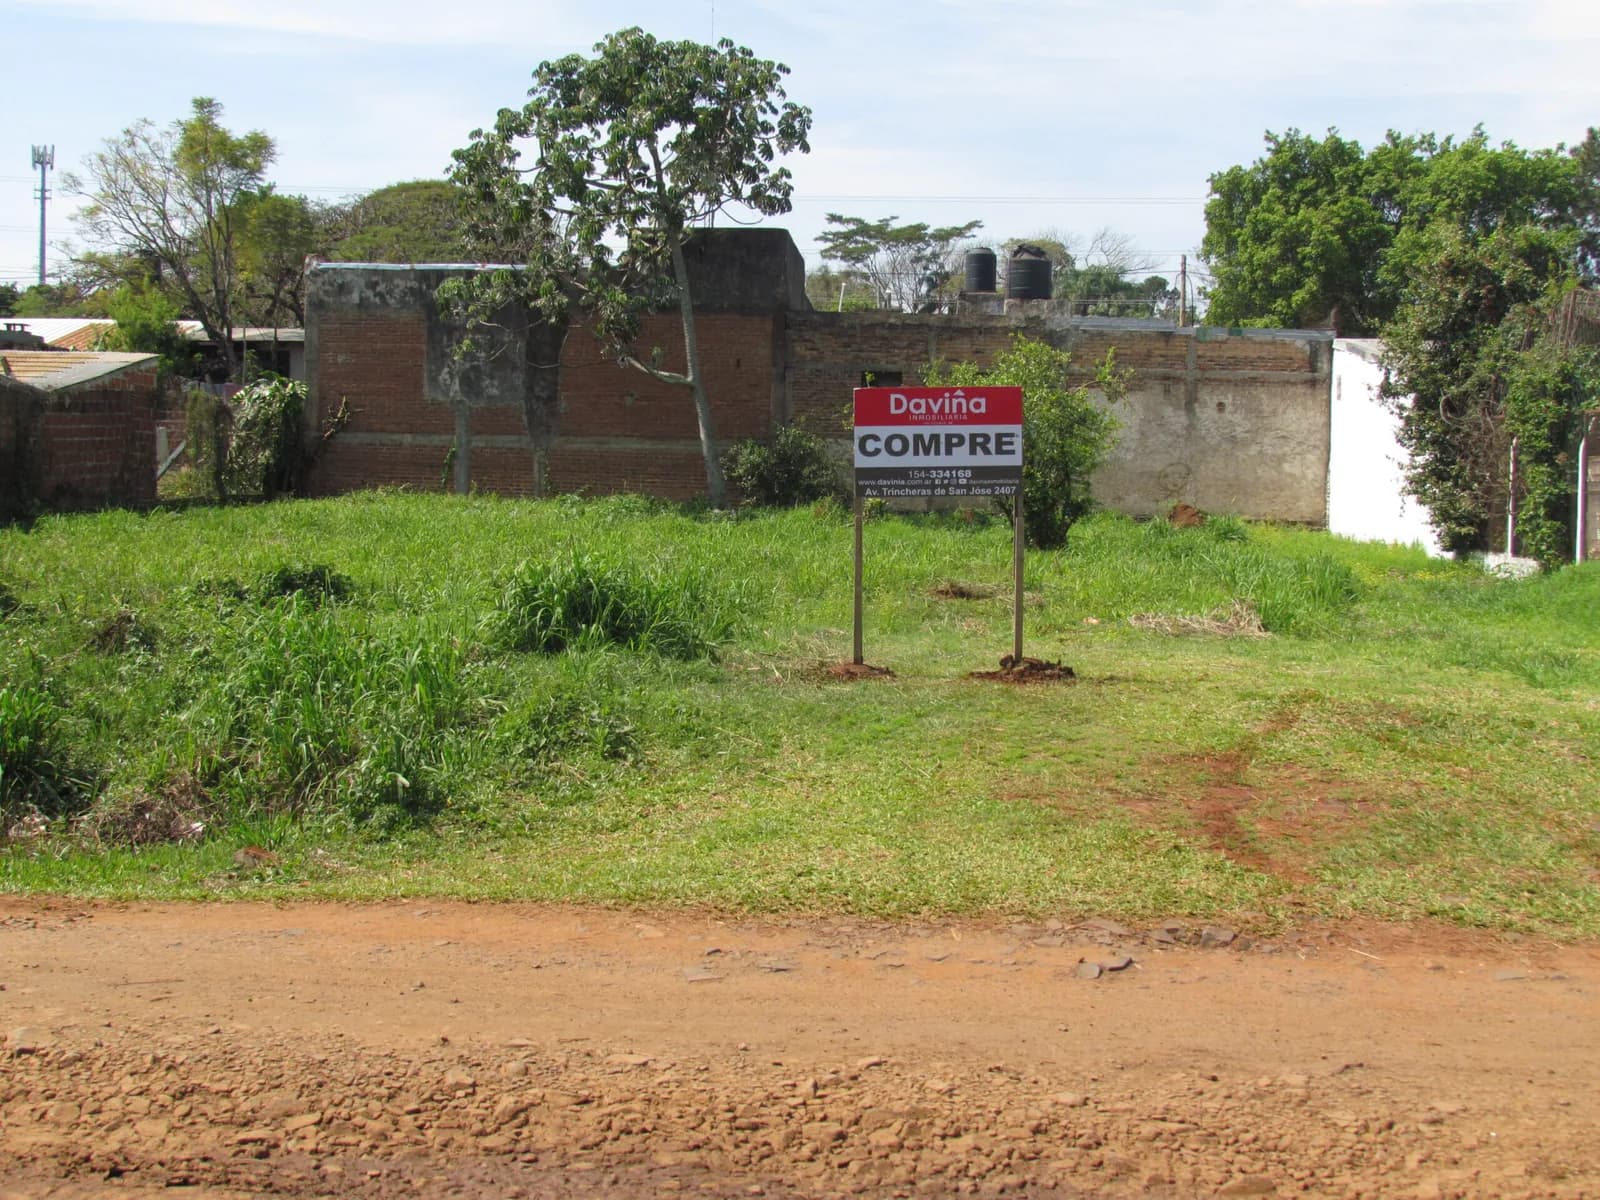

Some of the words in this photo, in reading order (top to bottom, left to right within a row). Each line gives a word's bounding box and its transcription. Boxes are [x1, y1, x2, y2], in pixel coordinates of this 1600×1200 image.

[858, 432, 1016, 457] COMPRE
[908, 469, 972, 479] 154-334168
[865, 488, 880, 496] Av.
[882, 487, 931, 496] Trincheras
[934, 487, 946, 495] de
[948, 486, 967, 495] San
[994, 486, 1016, 494] 2407
